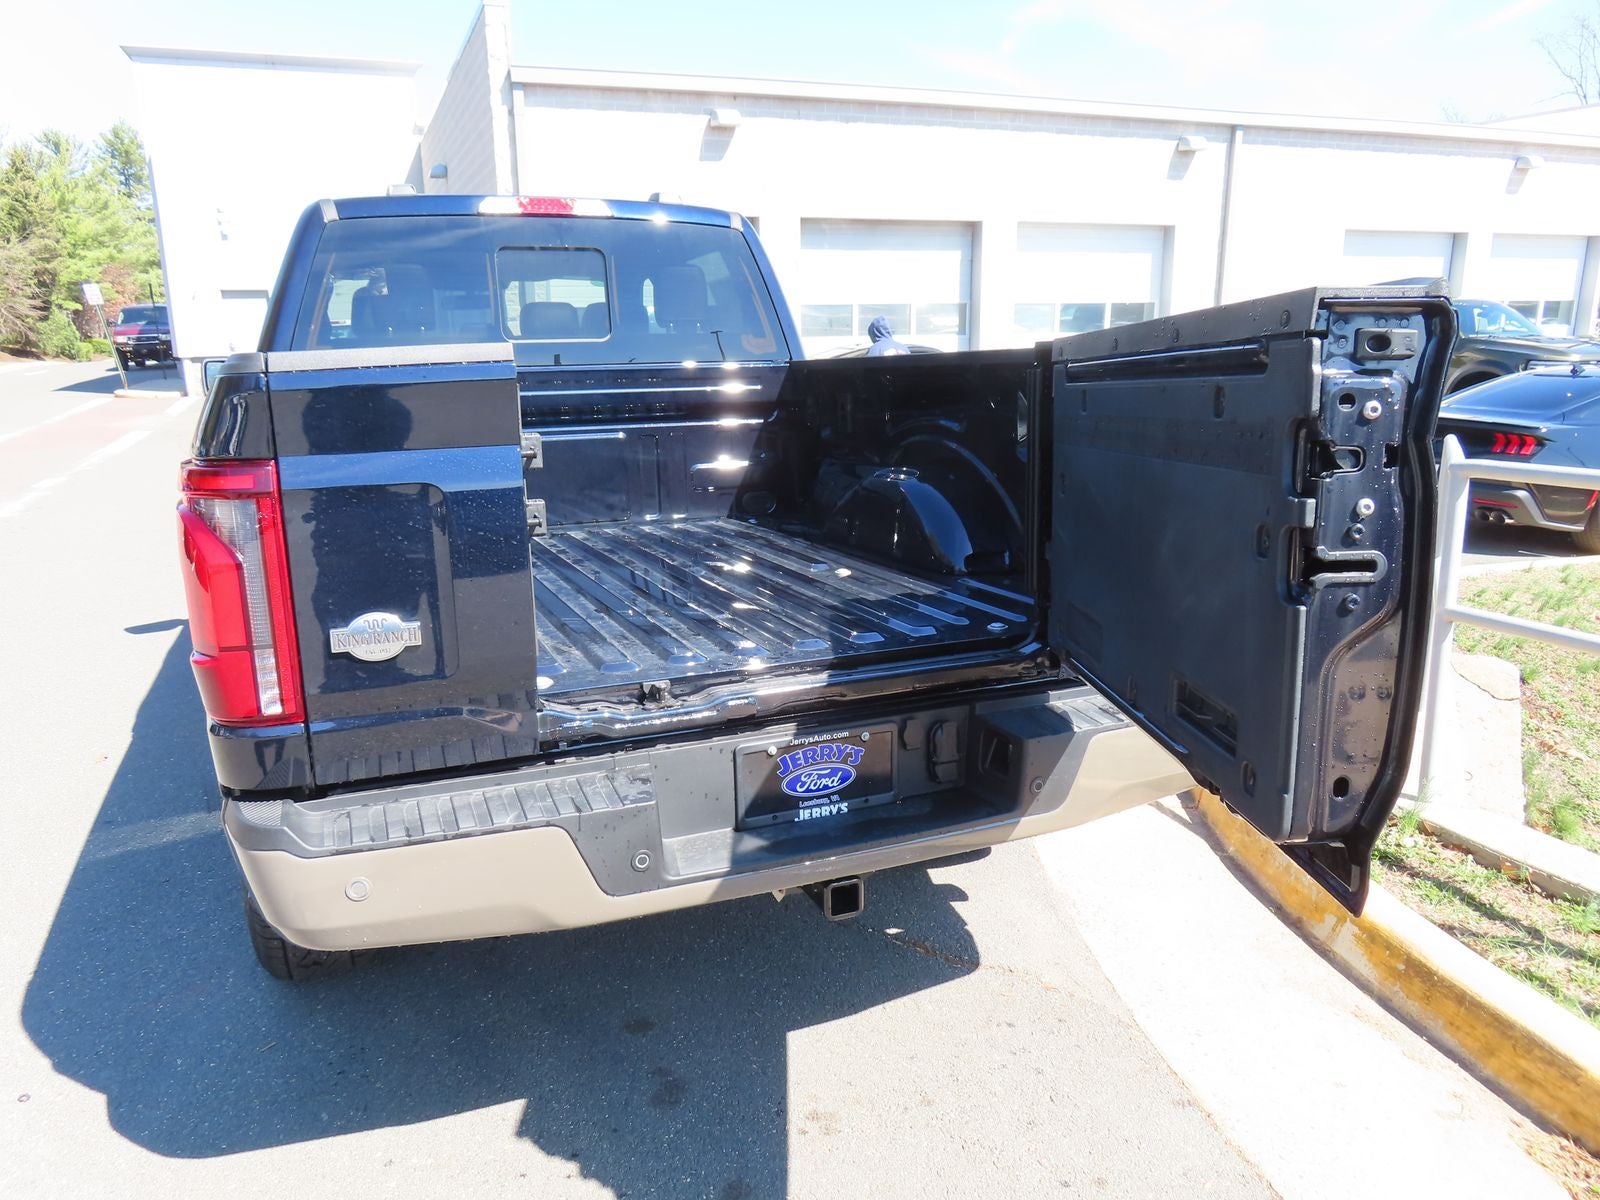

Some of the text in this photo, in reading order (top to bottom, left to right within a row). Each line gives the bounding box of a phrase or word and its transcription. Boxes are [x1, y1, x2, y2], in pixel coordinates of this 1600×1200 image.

[335, 627, 417, 648] KING RANCH
[790, 731, 849, 746] JerrysAuto.com
[777, 743, 865, 777] JERRY'S
[796, 769, 842, 792] Ford
[794, 802, 849, 822] JERRY'S
